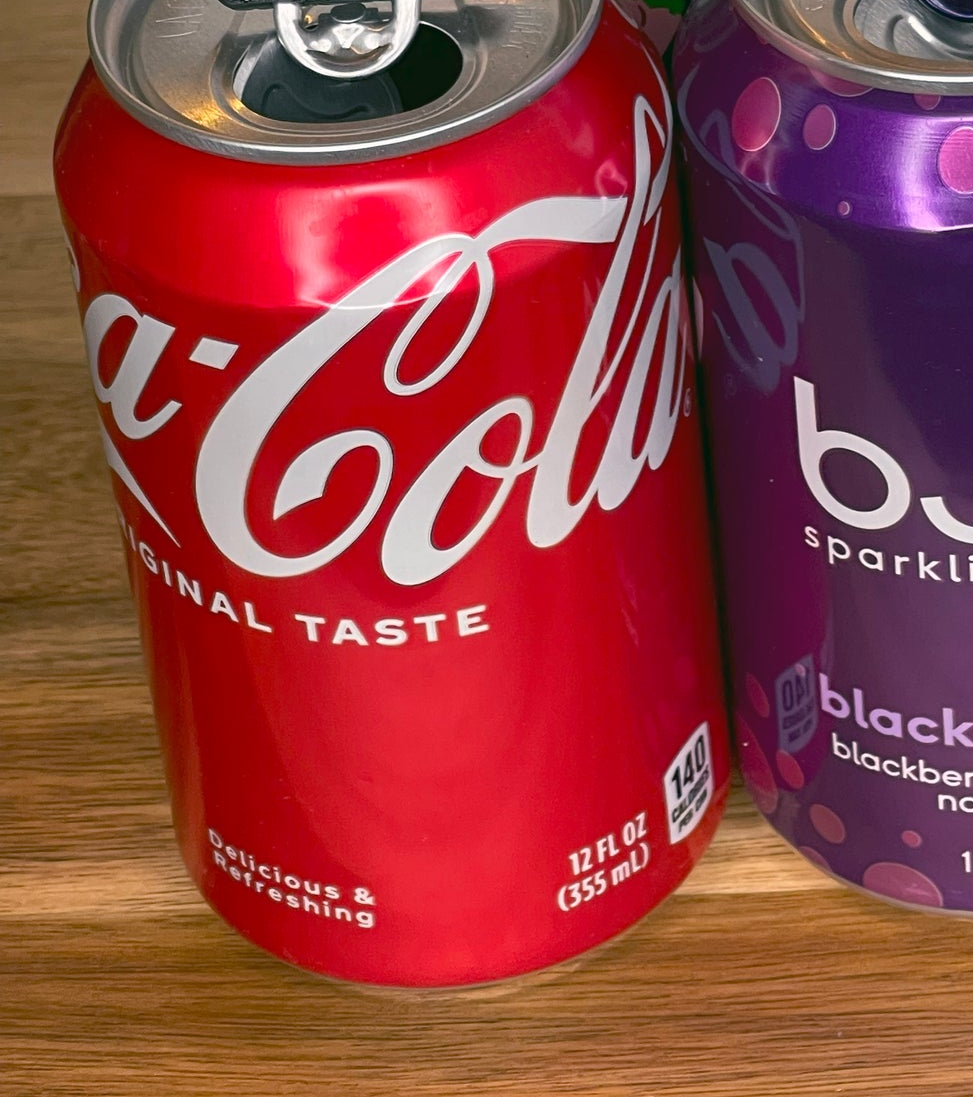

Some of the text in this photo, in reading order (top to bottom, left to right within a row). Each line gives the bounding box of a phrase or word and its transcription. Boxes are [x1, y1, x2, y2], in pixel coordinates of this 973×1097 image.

[65, 94, 692, 585] a-Cola
[118, 506, 491, 646] IGINAL TASTE
[671, 734, 706, 800] 140
[208, 827, 377, 905] Delicious &
[557, 843, 649, 912] (355 mL)
[568, 811, 647, 876] 12 FL OZ
[213, 850, 375, 929] Refreshing
